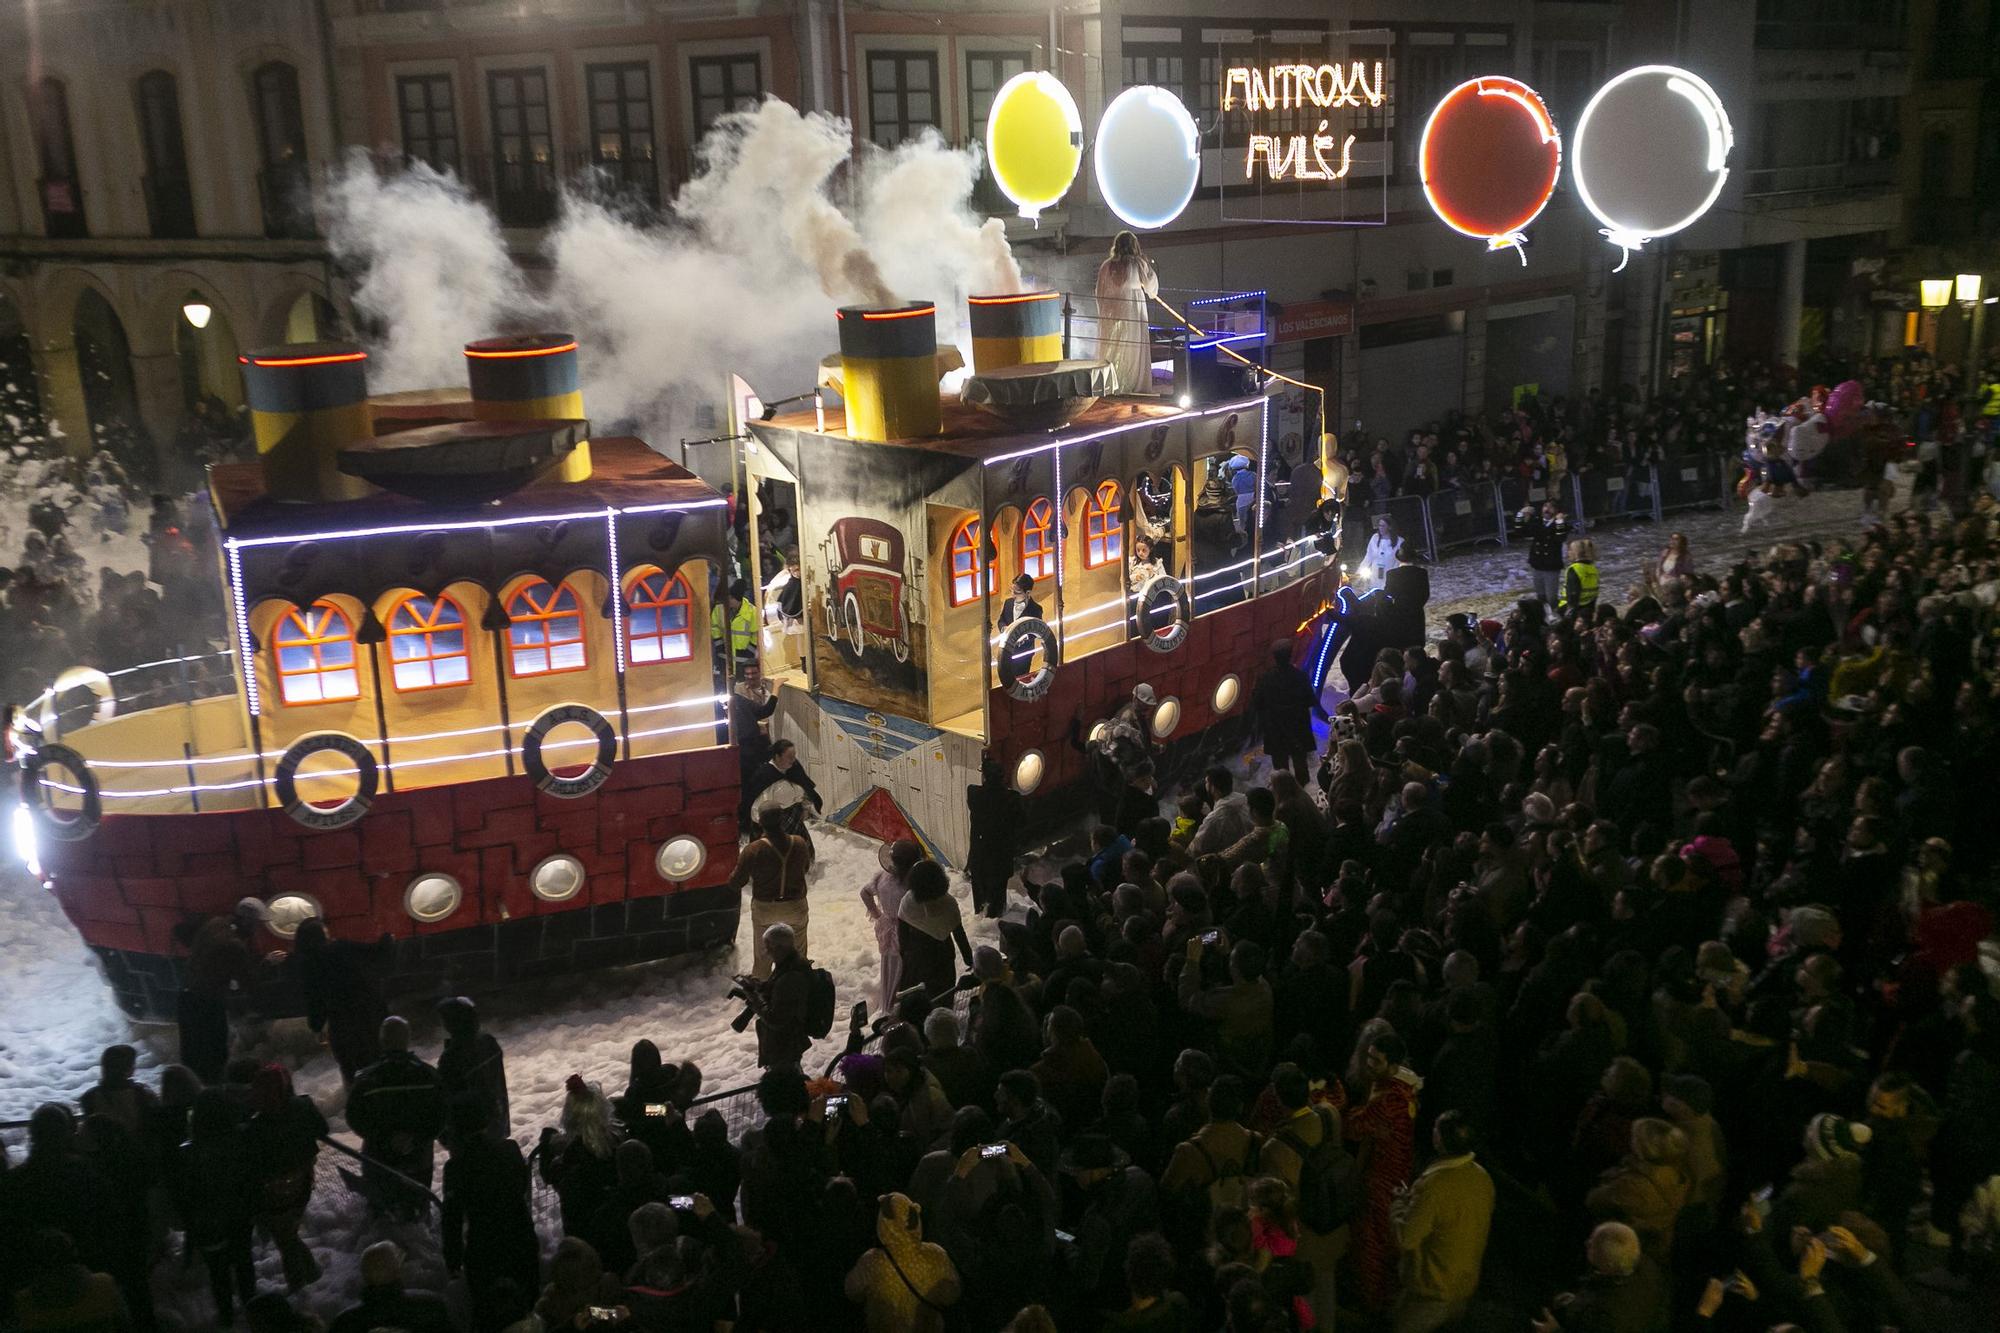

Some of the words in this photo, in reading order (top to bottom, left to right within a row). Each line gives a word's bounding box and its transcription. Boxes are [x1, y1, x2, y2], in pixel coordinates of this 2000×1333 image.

[1225, 61, 1383, 111] ANTROXU
[1278, 321, 1294, 334] LOS
[1295, 314, 1349, 332] VALENCIANOS
